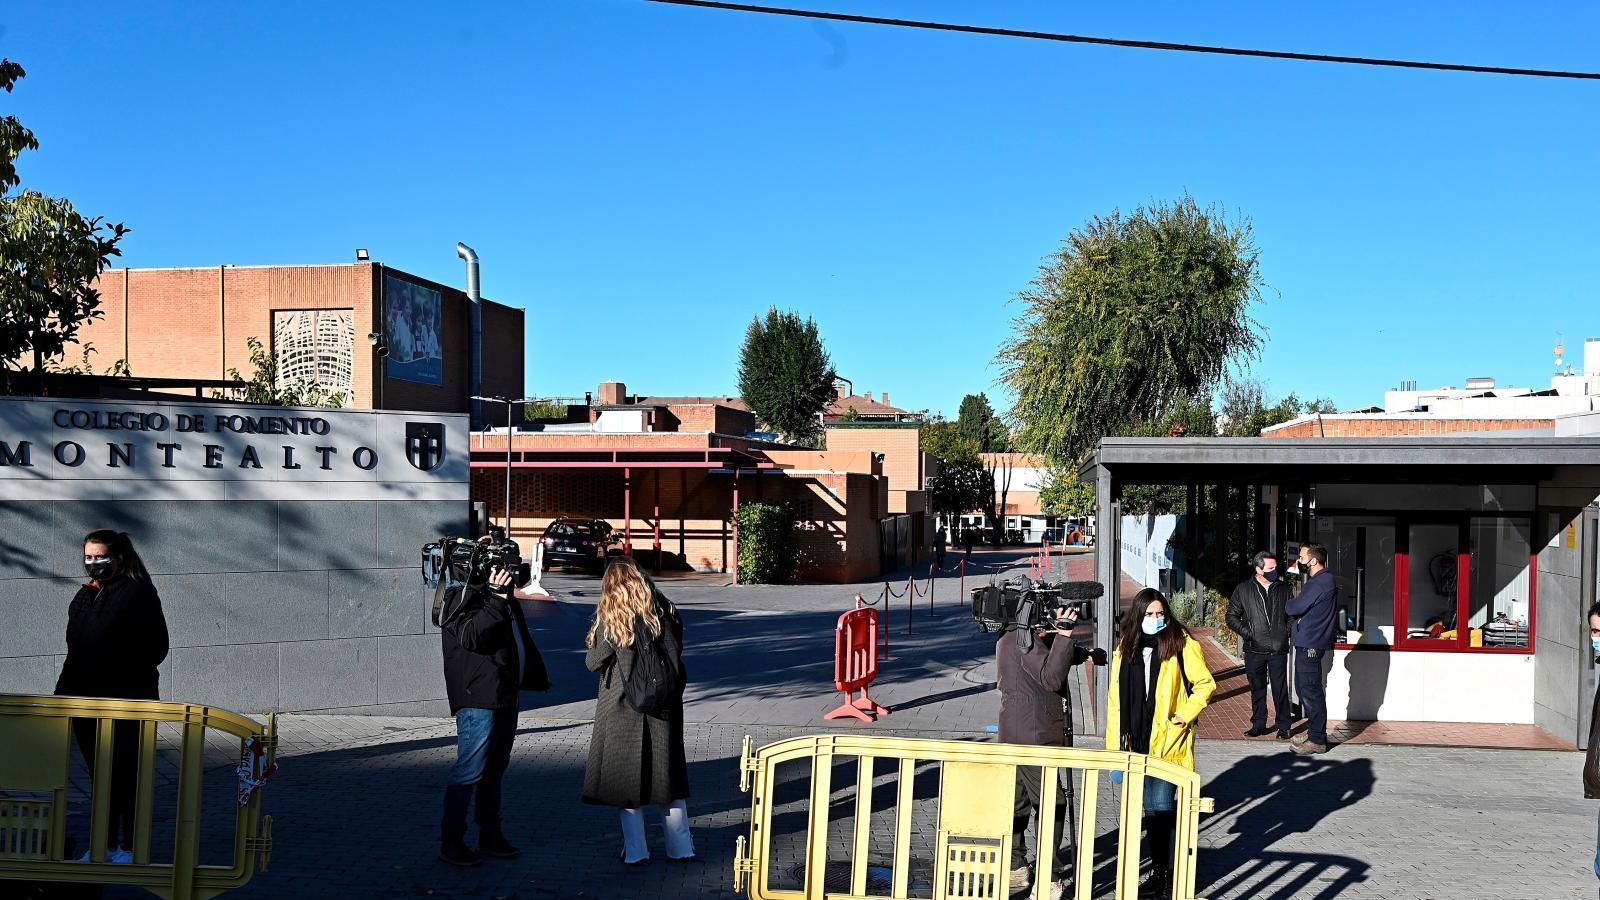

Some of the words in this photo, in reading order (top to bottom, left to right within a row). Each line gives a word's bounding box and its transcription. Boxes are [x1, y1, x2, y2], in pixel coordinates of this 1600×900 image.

[54, 409, 169, 432] COLEGIO
[176, 414, 206, 433] DE
[215, 415, 331, 435] FOMENTO
[0, 440, 378, 471] MONTEALTO
